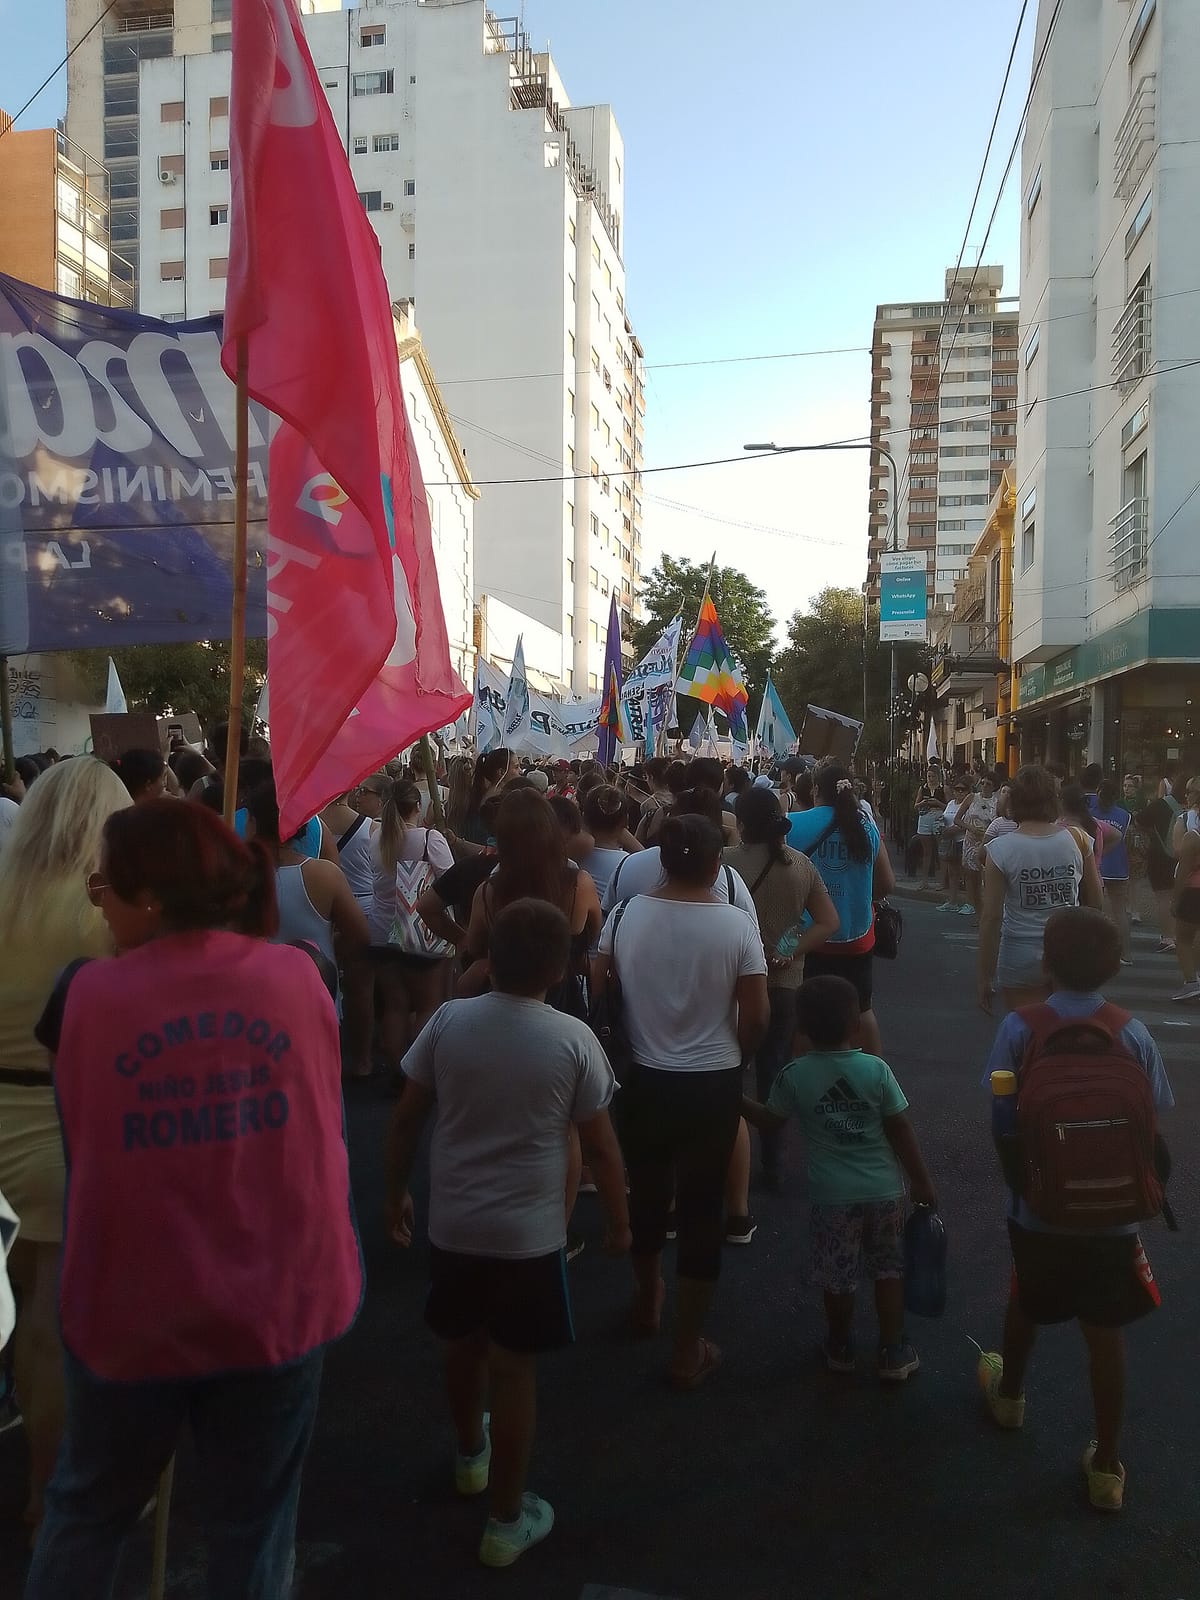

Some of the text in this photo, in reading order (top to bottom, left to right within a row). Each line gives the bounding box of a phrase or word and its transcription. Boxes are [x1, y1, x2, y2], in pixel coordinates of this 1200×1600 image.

[1020, 864, 1075, 881] SOMOS
[1026, 882, 1072, 895] BARRIOS
[1026, 892, 1071, 906] DE PIE
[115, 1011, 291, 1077] COMEDOR
[138, 1075, 196, 1099] NIÑO
[815, 1101, 870, 1115] adidas
[123, 1089, 289, 1151] ROMERO
